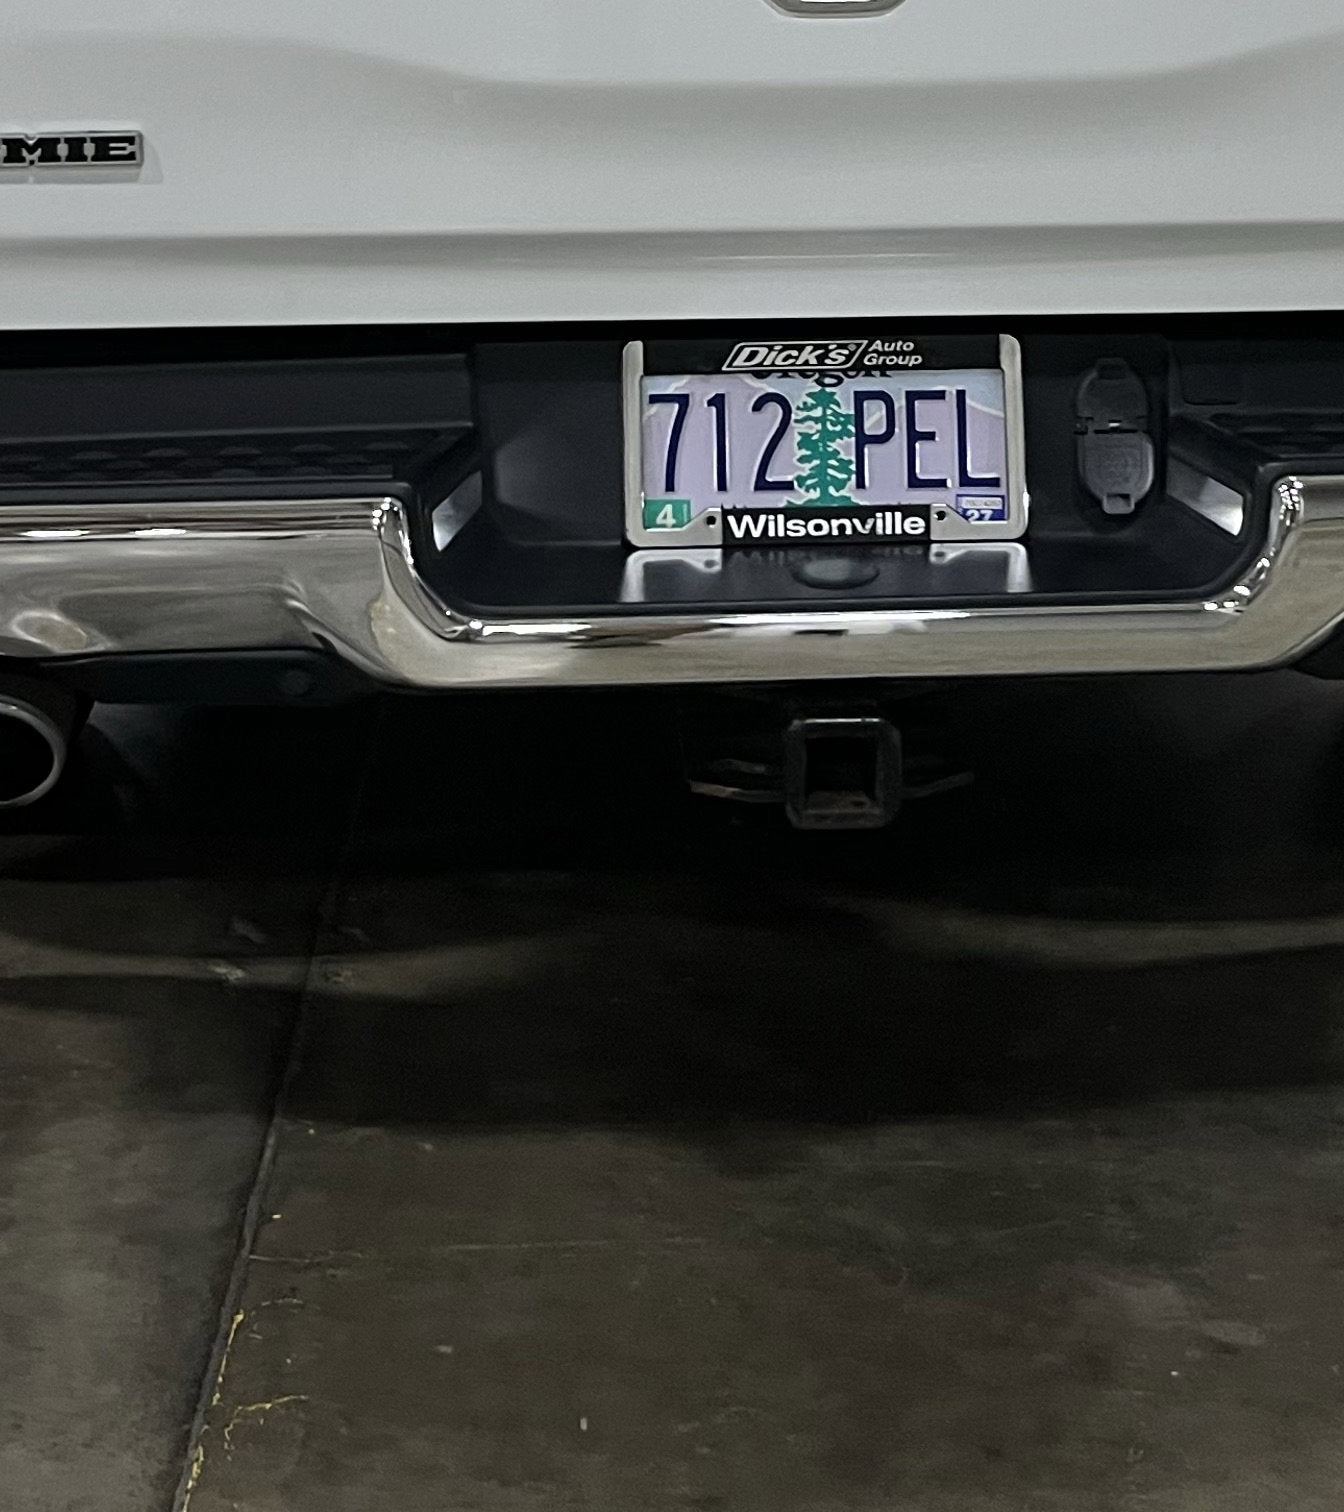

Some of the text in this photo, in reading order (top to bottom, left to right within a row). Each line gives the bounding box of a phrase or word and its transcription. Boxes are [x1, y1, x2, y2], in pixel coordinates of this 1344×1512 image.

[732, 344, 850, 367] Dick's
[868, 339, 915, 352] Auto
[863, 353, 923, 367] Group
[649, 389, 1001, 492] 712 PEL
[656, 503, 676, 528] 4
[727, 510, 926, 538] Wilsonville
[966, 509, 994, 522] 27
